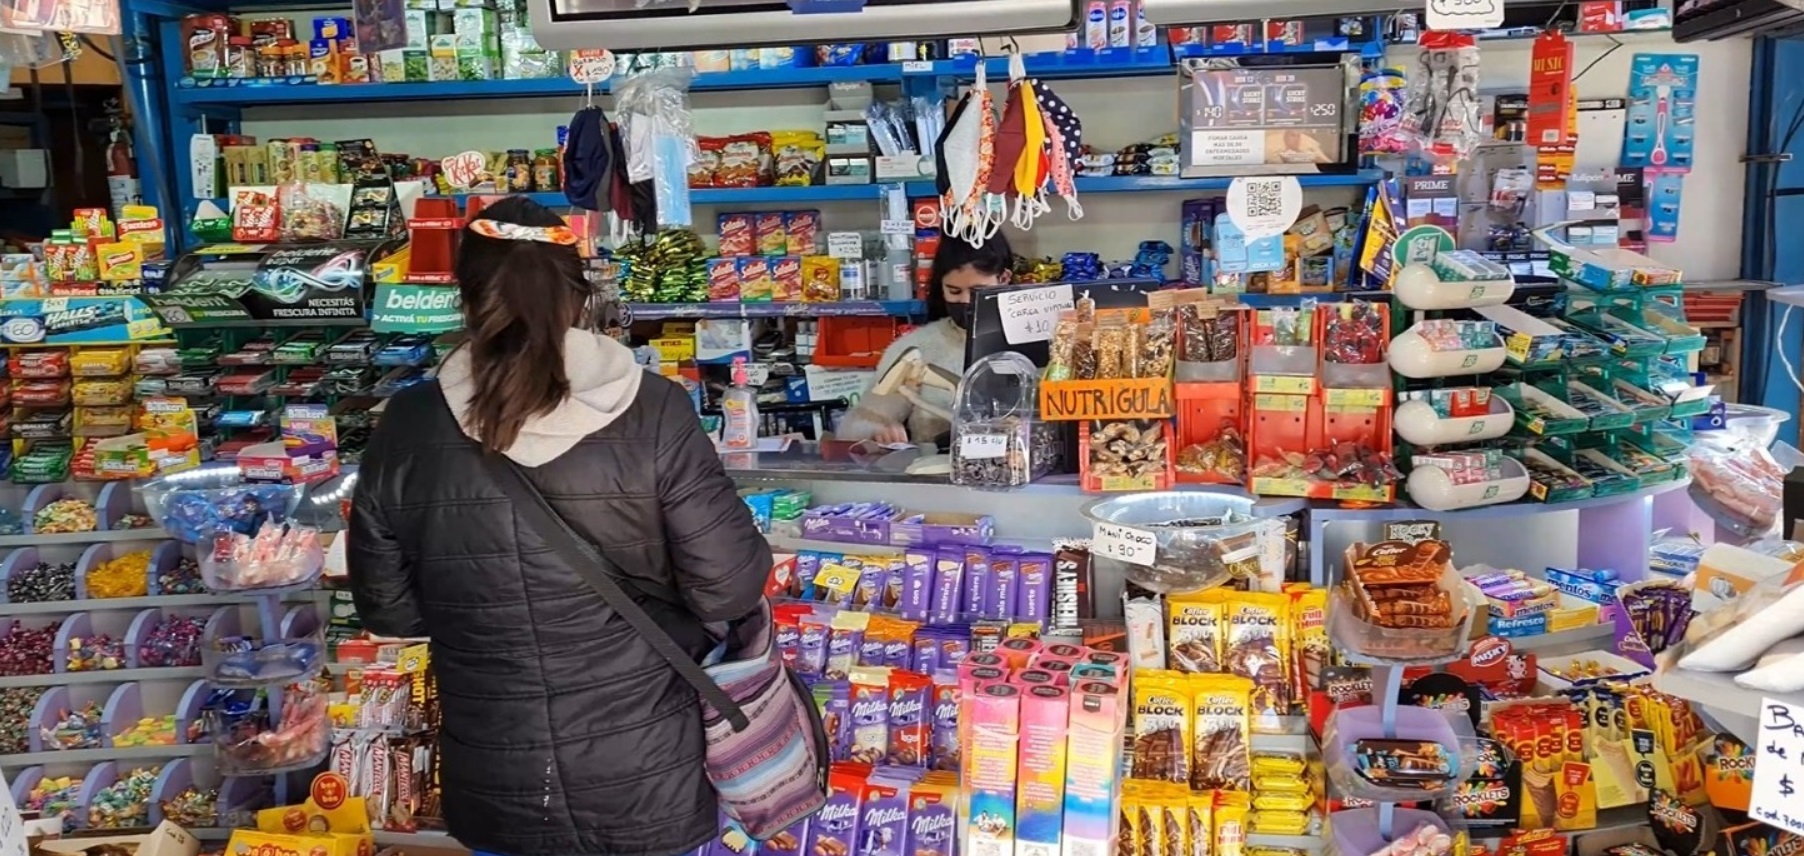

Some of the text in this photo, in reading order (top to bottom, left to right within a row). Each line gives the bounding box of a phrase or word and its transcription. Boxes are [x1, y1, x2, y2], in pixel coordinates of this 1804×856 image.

[1534, 57, 1563, 71] MUSIC
[1414, 180, 1449, 190] PRIME
[309, 297, 355, 306] NECESITÁS
[1009, 290, 1056, 305] SERVICIO
[45, 305, 96, 326] HALLS
[273, 308, 357, 317] FRESCURA INFINITA
[1046, 382, 1171, 417] NUTRIGULA
[1547, 578, 1592, 599] mentos
[1515, 600, 1556, 616] mentos
[1172, 616, 1217, 626] BLOCK
[1231, 615, 1277, 626] BLOCK
[1497, 616, 1545, 629] Refresco
[1330, 682, 1373, 696] ROCKLET
[853, 701, 888, 717] Milka
[889, 701, 922, 717] Milka
[936, 703, 959, 717] Mil
[1138, 706, 1184, 717] BLOCK
[1197, 706, 1244, 717] BLOCK
[1767, 740, 1787, 759] de
[1720, 754, 1755, 771] ROCK
[1779, 773, 1795, 798] $
[1453, 787, 1510, 806] ROCKLETS
[820, 802, 858, 820] Milka
[865, 806, 907, 827] Milka
[912, 814, 955, 833] Milka
